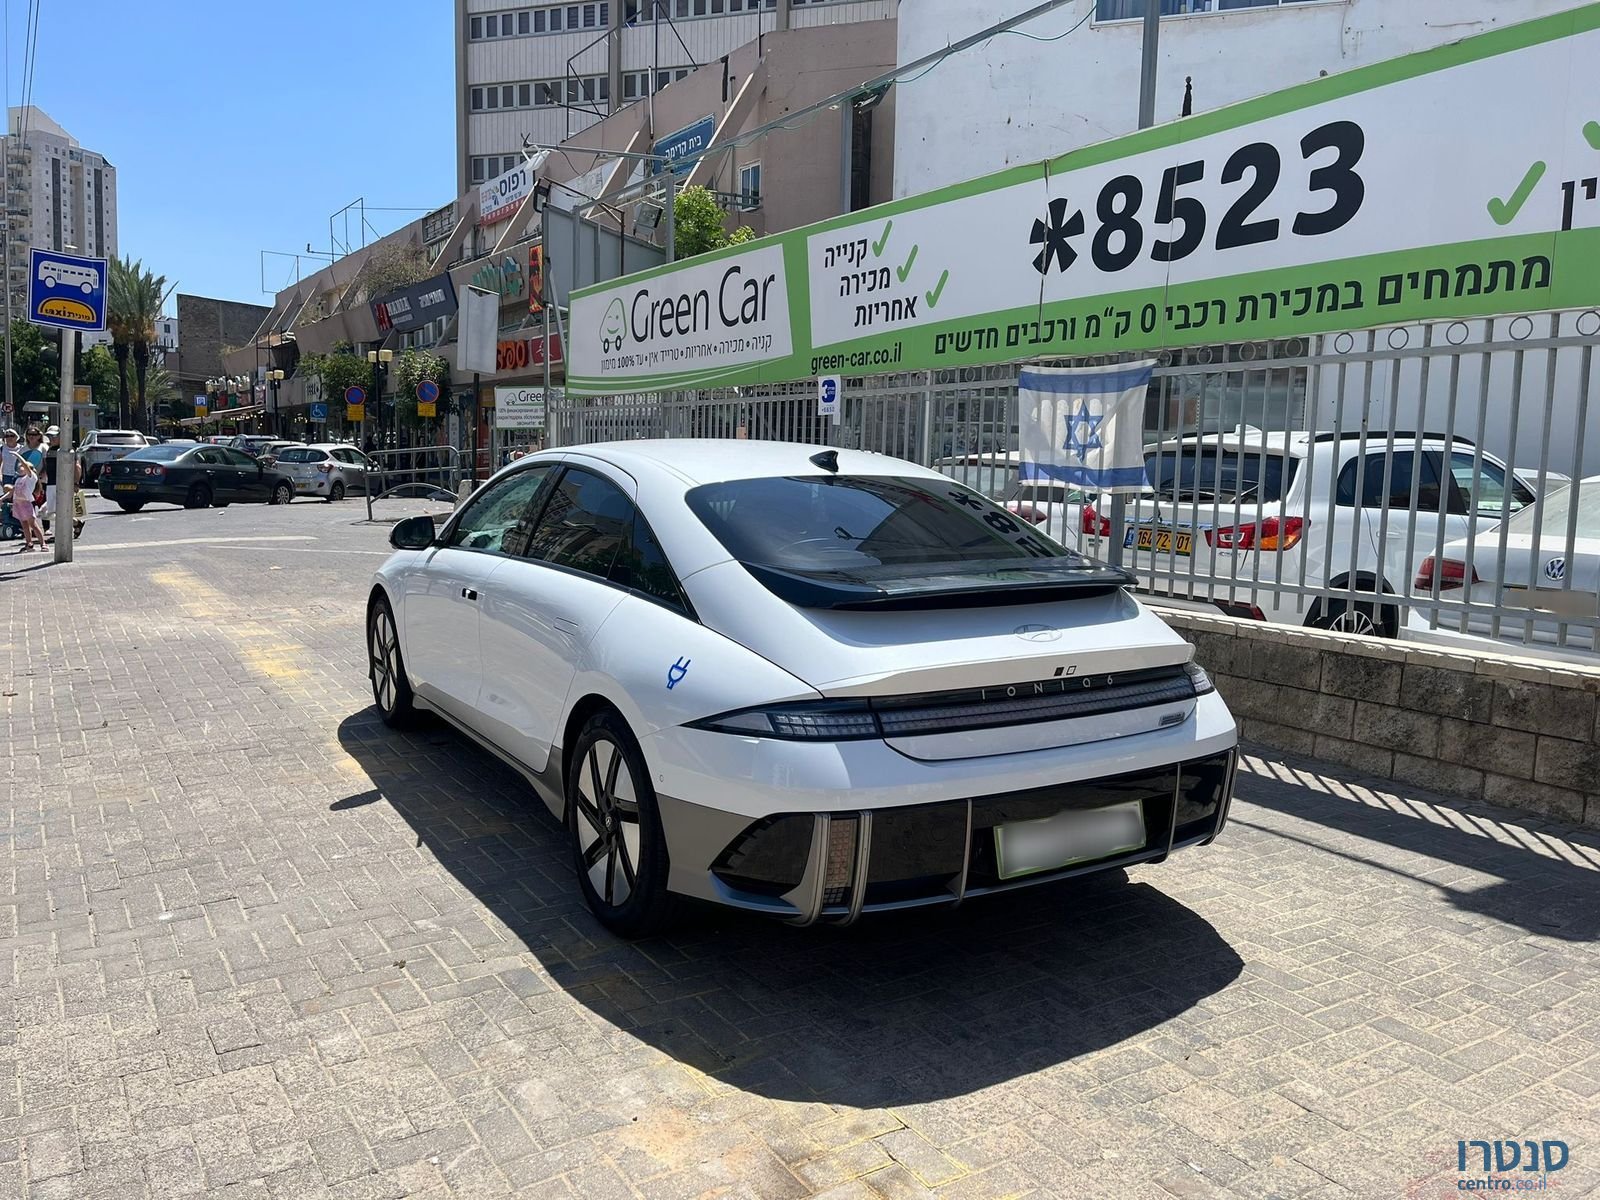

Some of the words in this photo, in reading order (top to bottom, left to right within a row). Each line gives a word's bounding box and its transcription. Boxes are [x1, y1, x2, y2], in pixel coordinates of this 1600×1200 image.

[824, 238, 868, 268] קנייה
[840, 266, 891, 297] מכירה
[1377, 255, 1550, 306] מתמחים
[45, 306, 66, 317] taxi
[631, 289, 710, 342] Green
[719, 265, 775, 327] Car
[854, 296, 918, 327] אחריות
[1166, 299, 1226, 331] רכבי
[1236, 280, 1364, 324] במכירת
[719, 338, 744, 354] מכירה
[752, 334, 772, 353] קניה
[935, 327, 999, 355] חדשים
[1006, 317, 1077, 346] ורכבים
[617, 355, 635, 369] 100%
[685, 343, 713, 359] אחריות
[811, 341, 902, 375] green-car.co.il
[981, 677, 1091, 701] IONIQ
[1107, 674, 1113, 685] 6
